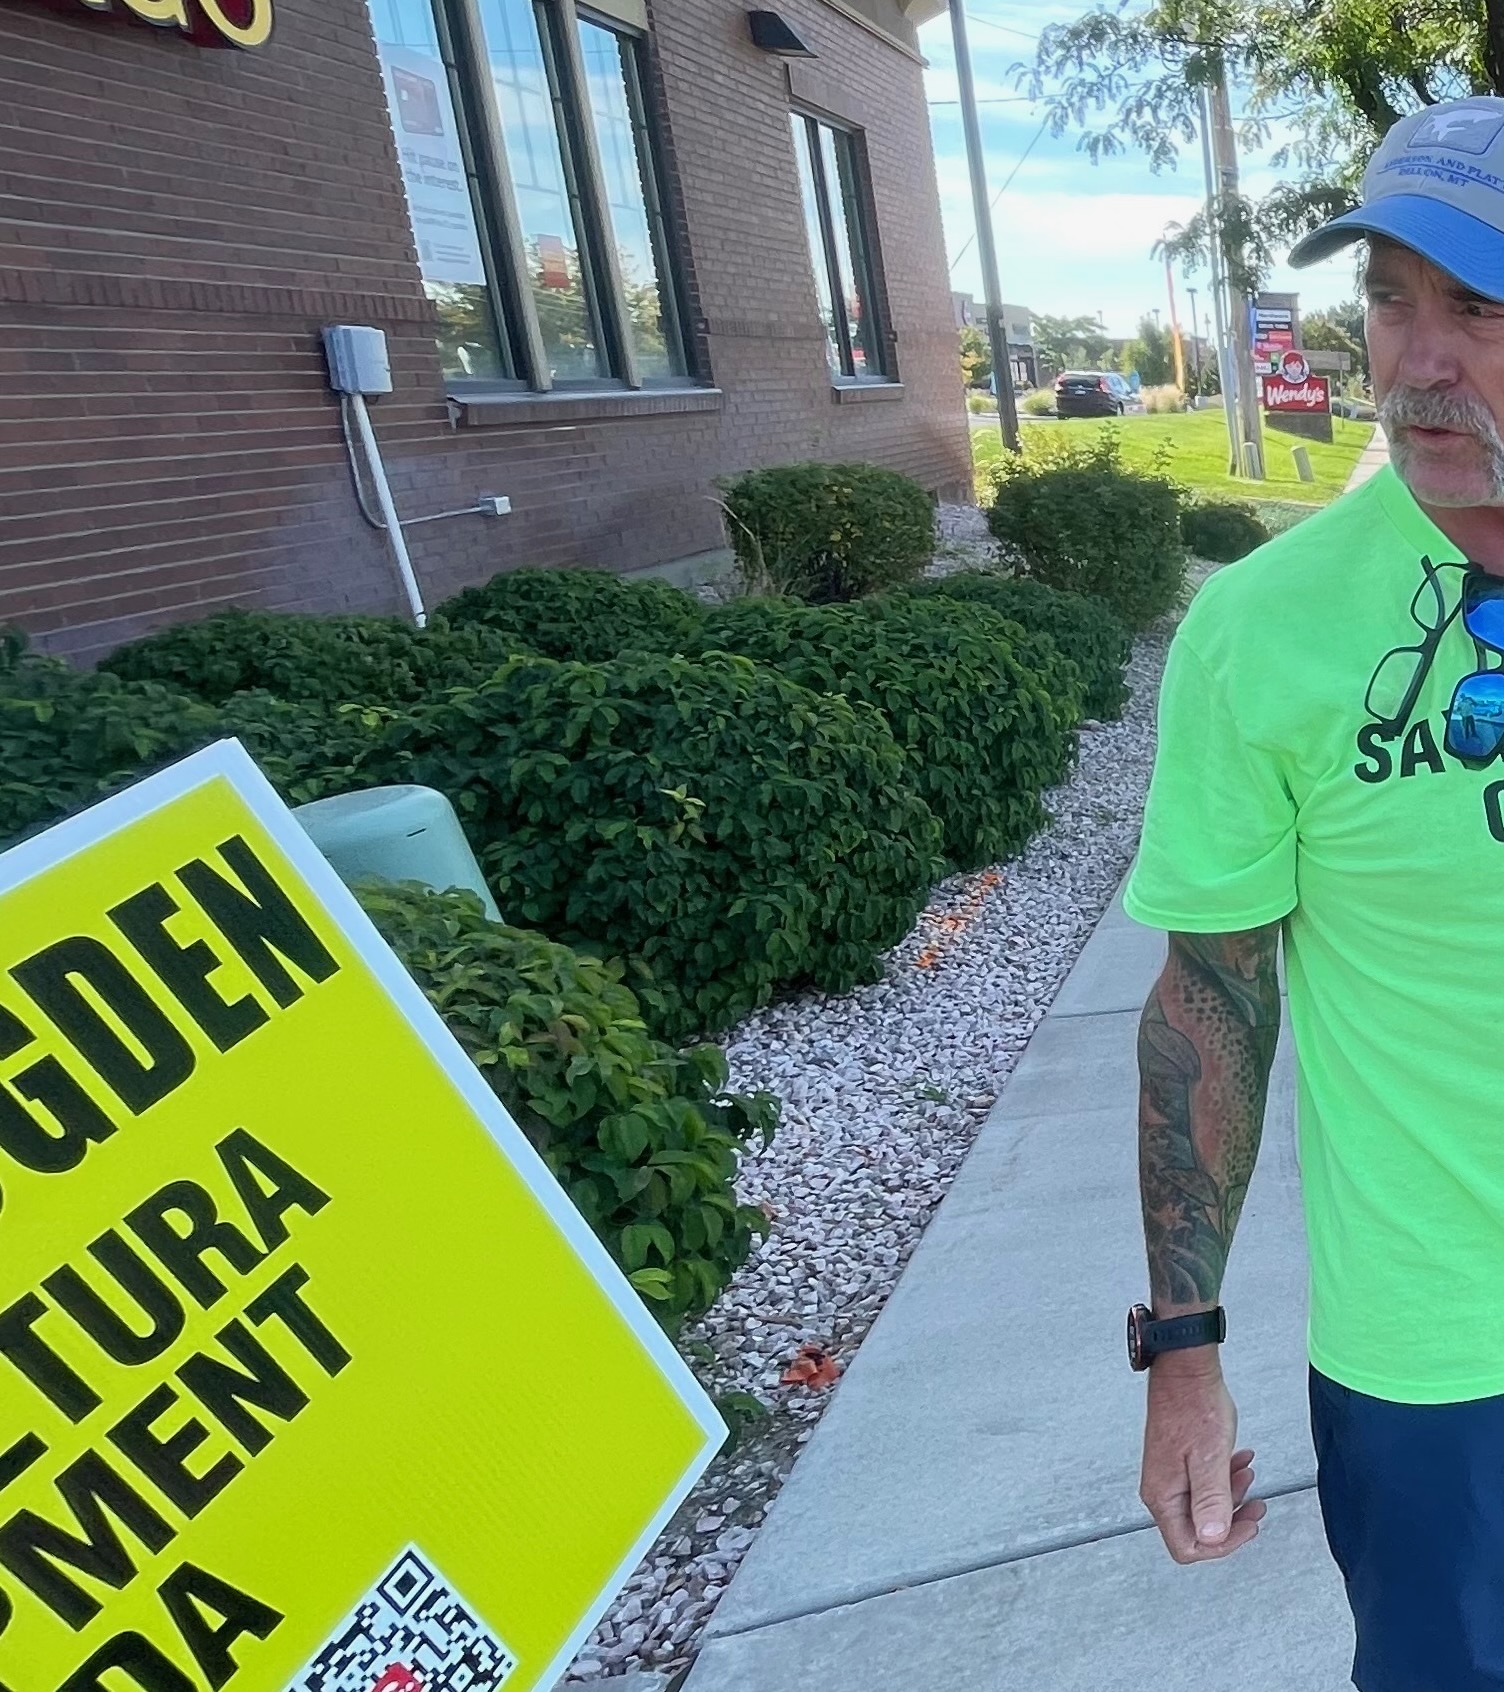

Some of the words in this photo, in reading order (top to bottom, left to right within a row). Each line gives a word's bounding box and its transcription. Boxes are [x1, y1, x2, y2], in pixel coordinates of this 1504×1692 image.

[1437, 157, 1466, 171] AND
[1266, 383, 1325, 407] Wendy's
[0, 834, 341, 1202] GDEN
[0, 1127, 332, 1489] TURA
[0, 1263, 352, 1640] MENT
